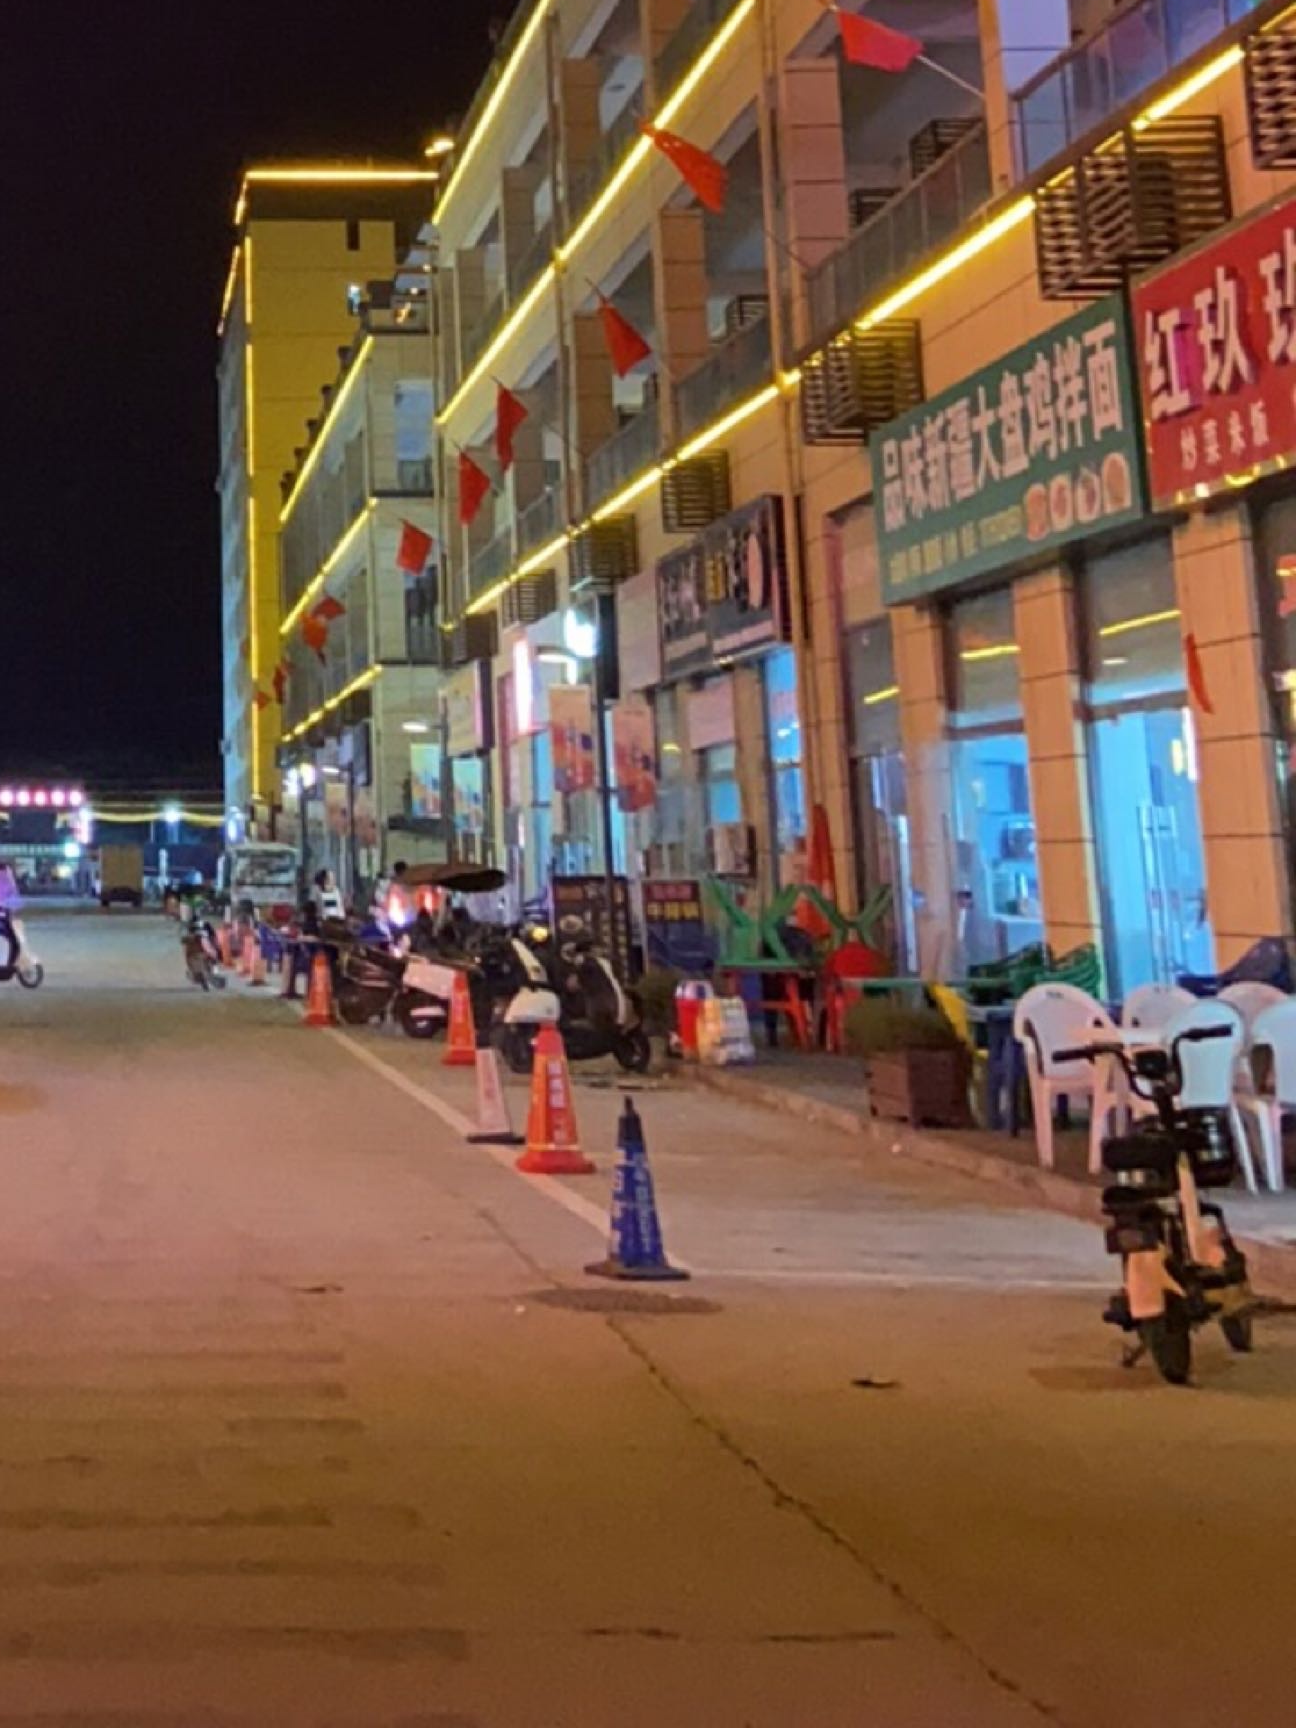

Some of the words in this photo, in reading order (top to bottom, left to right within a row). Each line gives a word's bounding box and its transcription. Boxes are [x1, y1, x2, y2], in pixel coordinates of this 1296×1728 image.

[883, 319, 1123, 533] 品味新疆大盘鸡拌面
